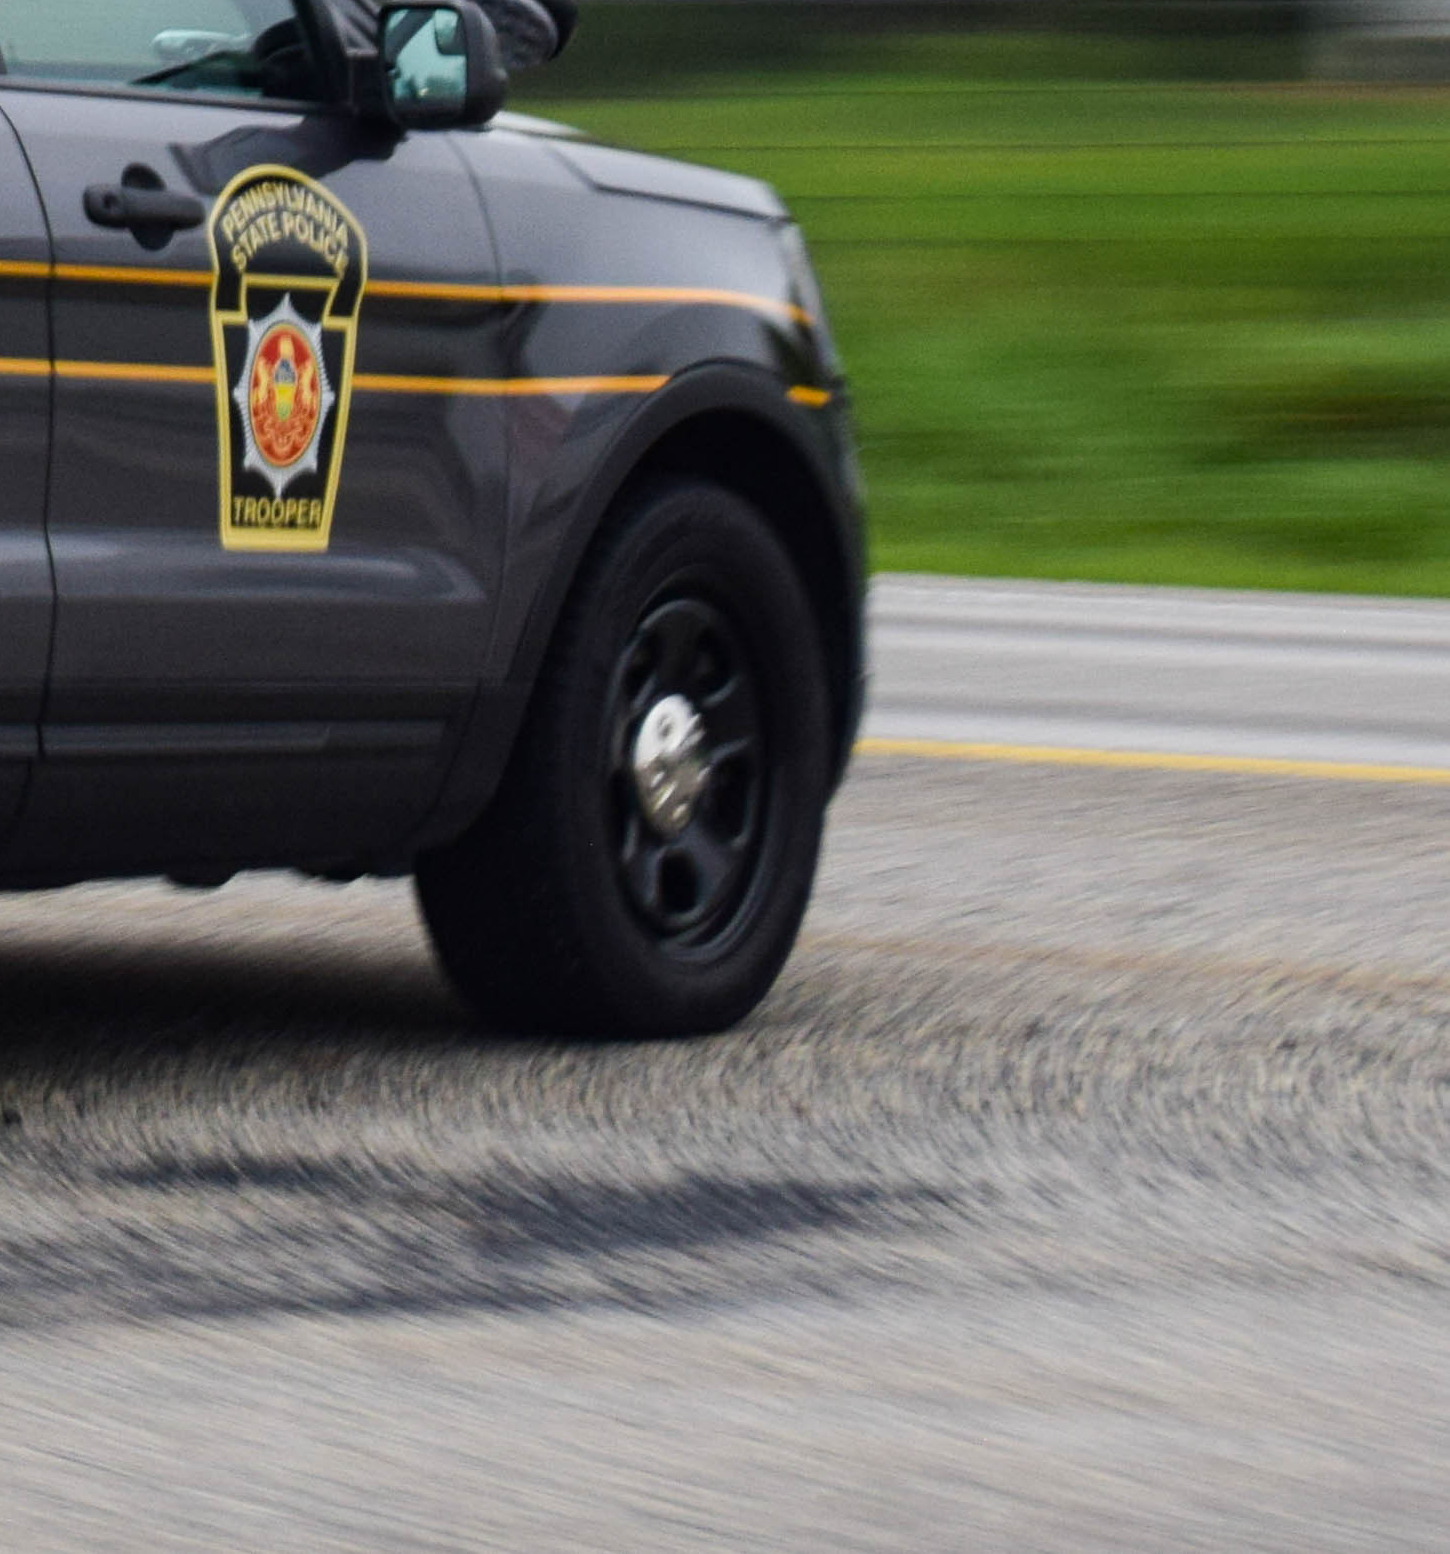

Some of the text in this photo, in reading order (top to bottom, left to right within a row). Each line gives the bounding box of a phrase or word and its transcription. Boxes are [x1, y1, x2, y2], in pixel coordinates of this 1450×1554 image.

[221, 181, 349, 246] PENNSYLVANIA
[231, 209, 349, 280] STATE POLICE
[233, 496, 322, 526] TROOPER
